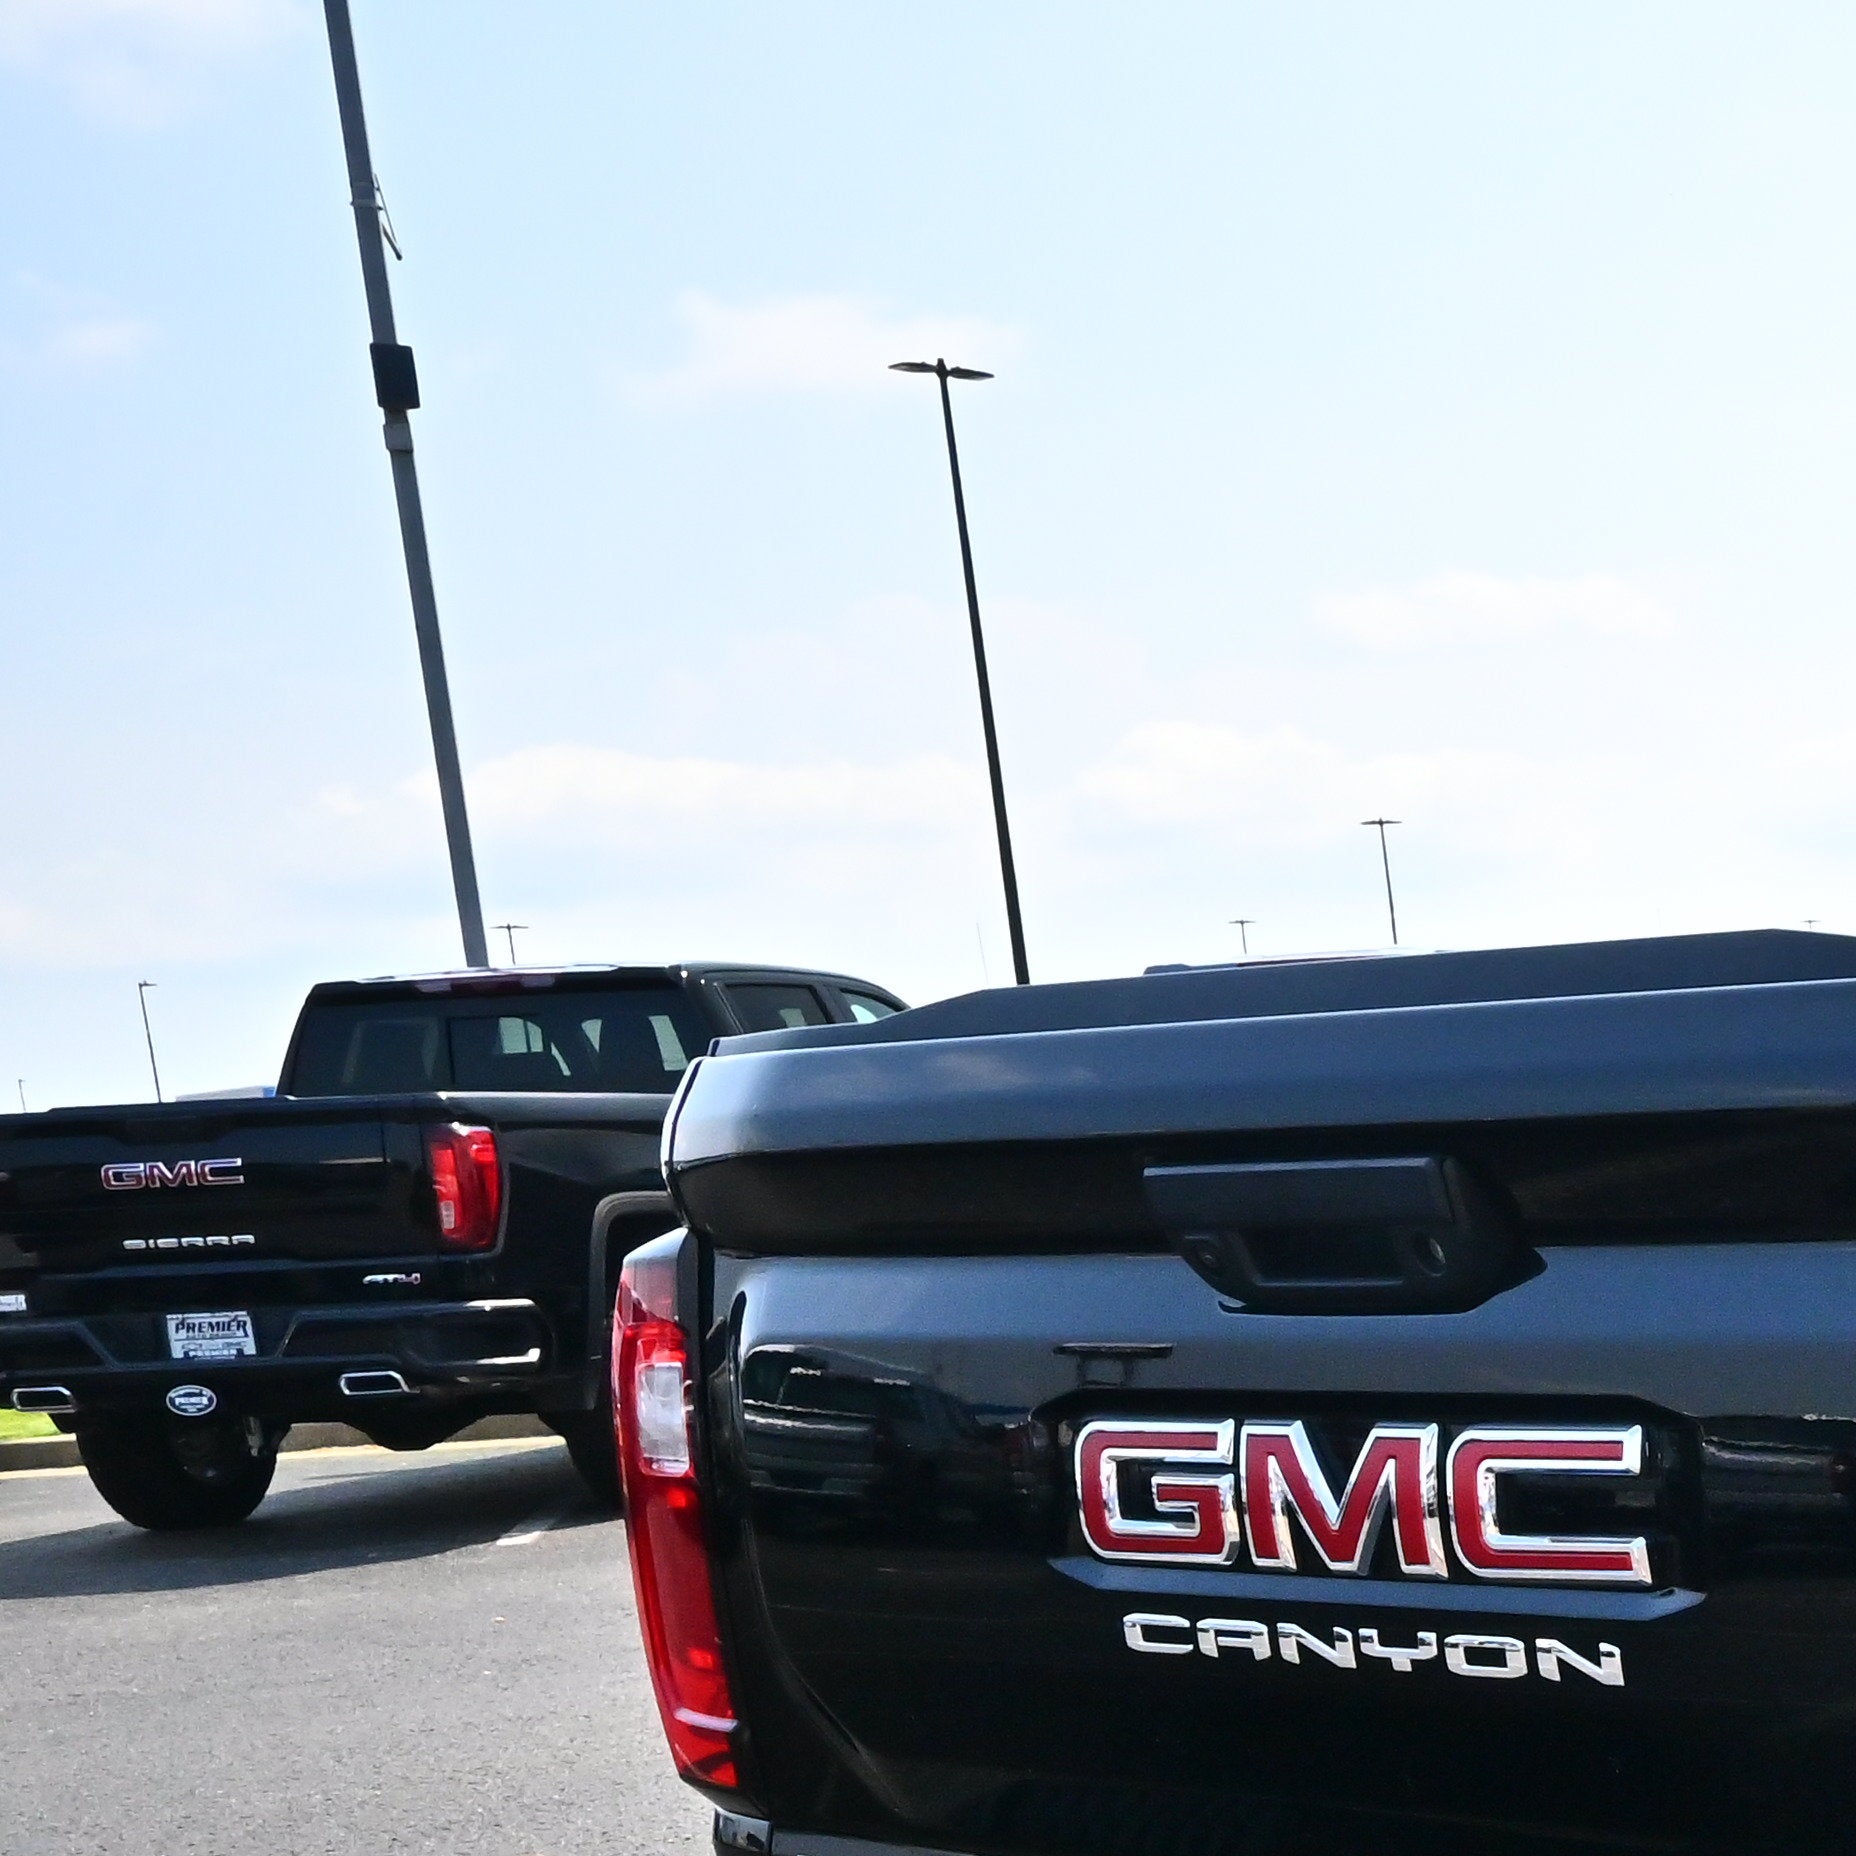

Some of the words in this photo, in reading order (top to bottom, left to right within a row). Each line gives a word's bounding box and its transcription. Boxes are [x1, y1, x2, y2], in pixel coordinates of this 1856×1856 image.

[100, 1157, 245, 1190] GMC
[122, 1234, 255, 1250] SIERRA
[174, 1319, 249, 1338] PREMIER
[1075, 1417, 1653, 1585] GMC
[1122, 1611, 1626, 1687] CANYON
